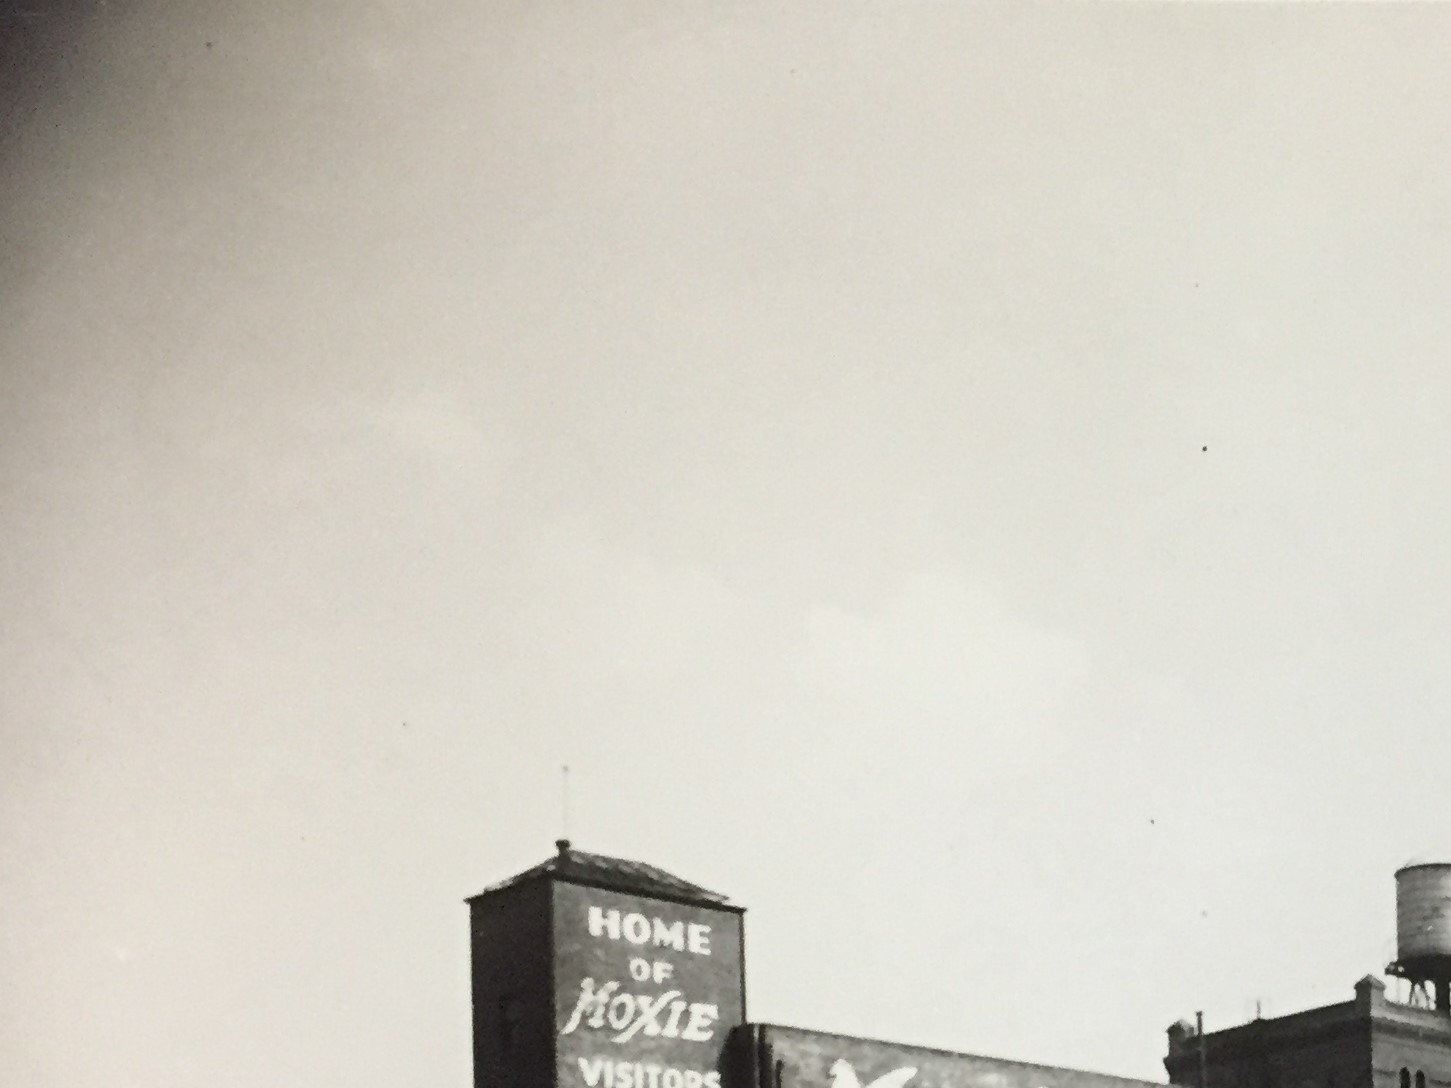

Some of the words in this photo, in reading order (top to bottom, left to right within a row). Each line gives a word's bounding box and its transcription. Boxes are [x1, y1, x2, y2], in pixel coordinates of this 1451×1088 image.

[587, 906, 712, 955] HOME
[629, 957, 674, 984] OF
[560, 977, 719, 1044] MOXIE
